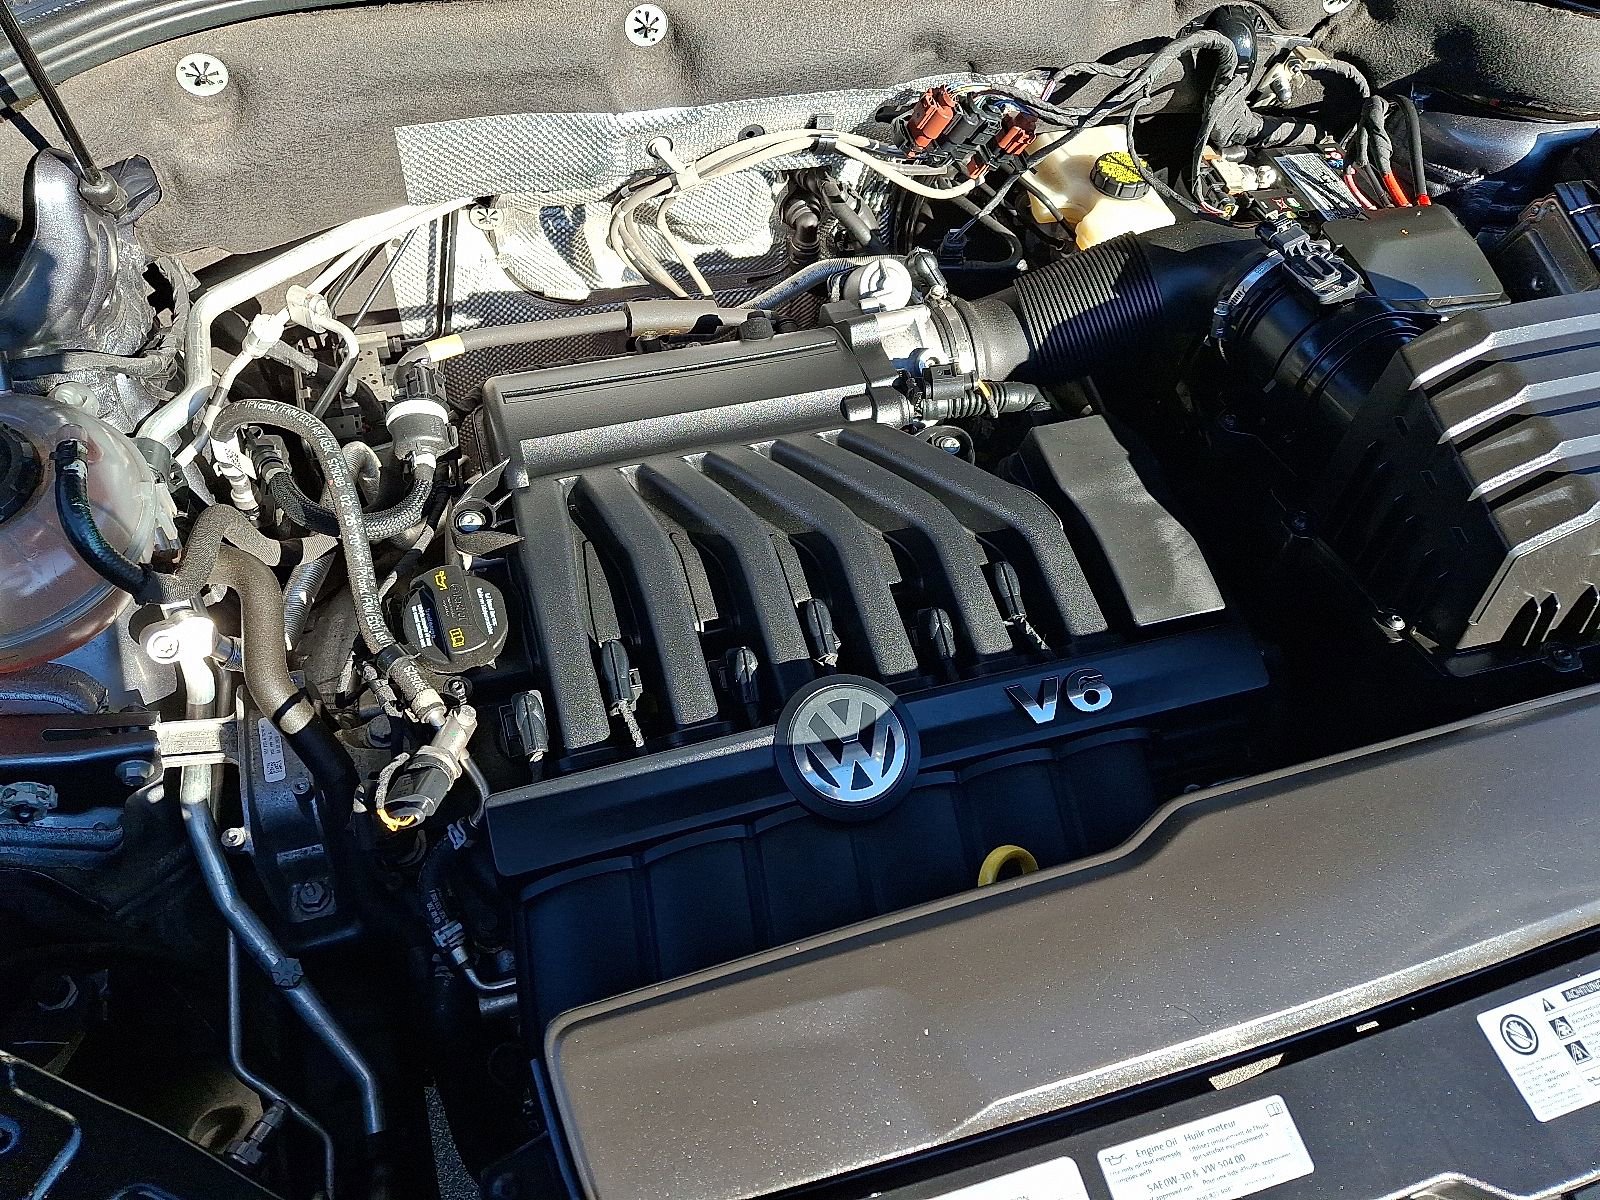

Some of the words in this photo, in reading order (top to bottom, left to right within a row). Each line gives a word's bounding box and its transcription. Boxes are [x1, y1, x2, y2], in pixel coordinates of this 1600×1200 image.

[1003, 668, 1113, 724] V6
[790, 684, 906, 802] VW
[1183, 1129, 1205, 1142] Huile
[1207, 1120, 1236, 1134] moteur
[1135, 1142, 1164, 1158] Engine
[1165, 1137, 1178, 1148] Oil
[1200, 1162, 1217, 1174] VW
[1217, 1157, 1234, 1169] 504
[1234, 1153, 1246, 1164] 00
